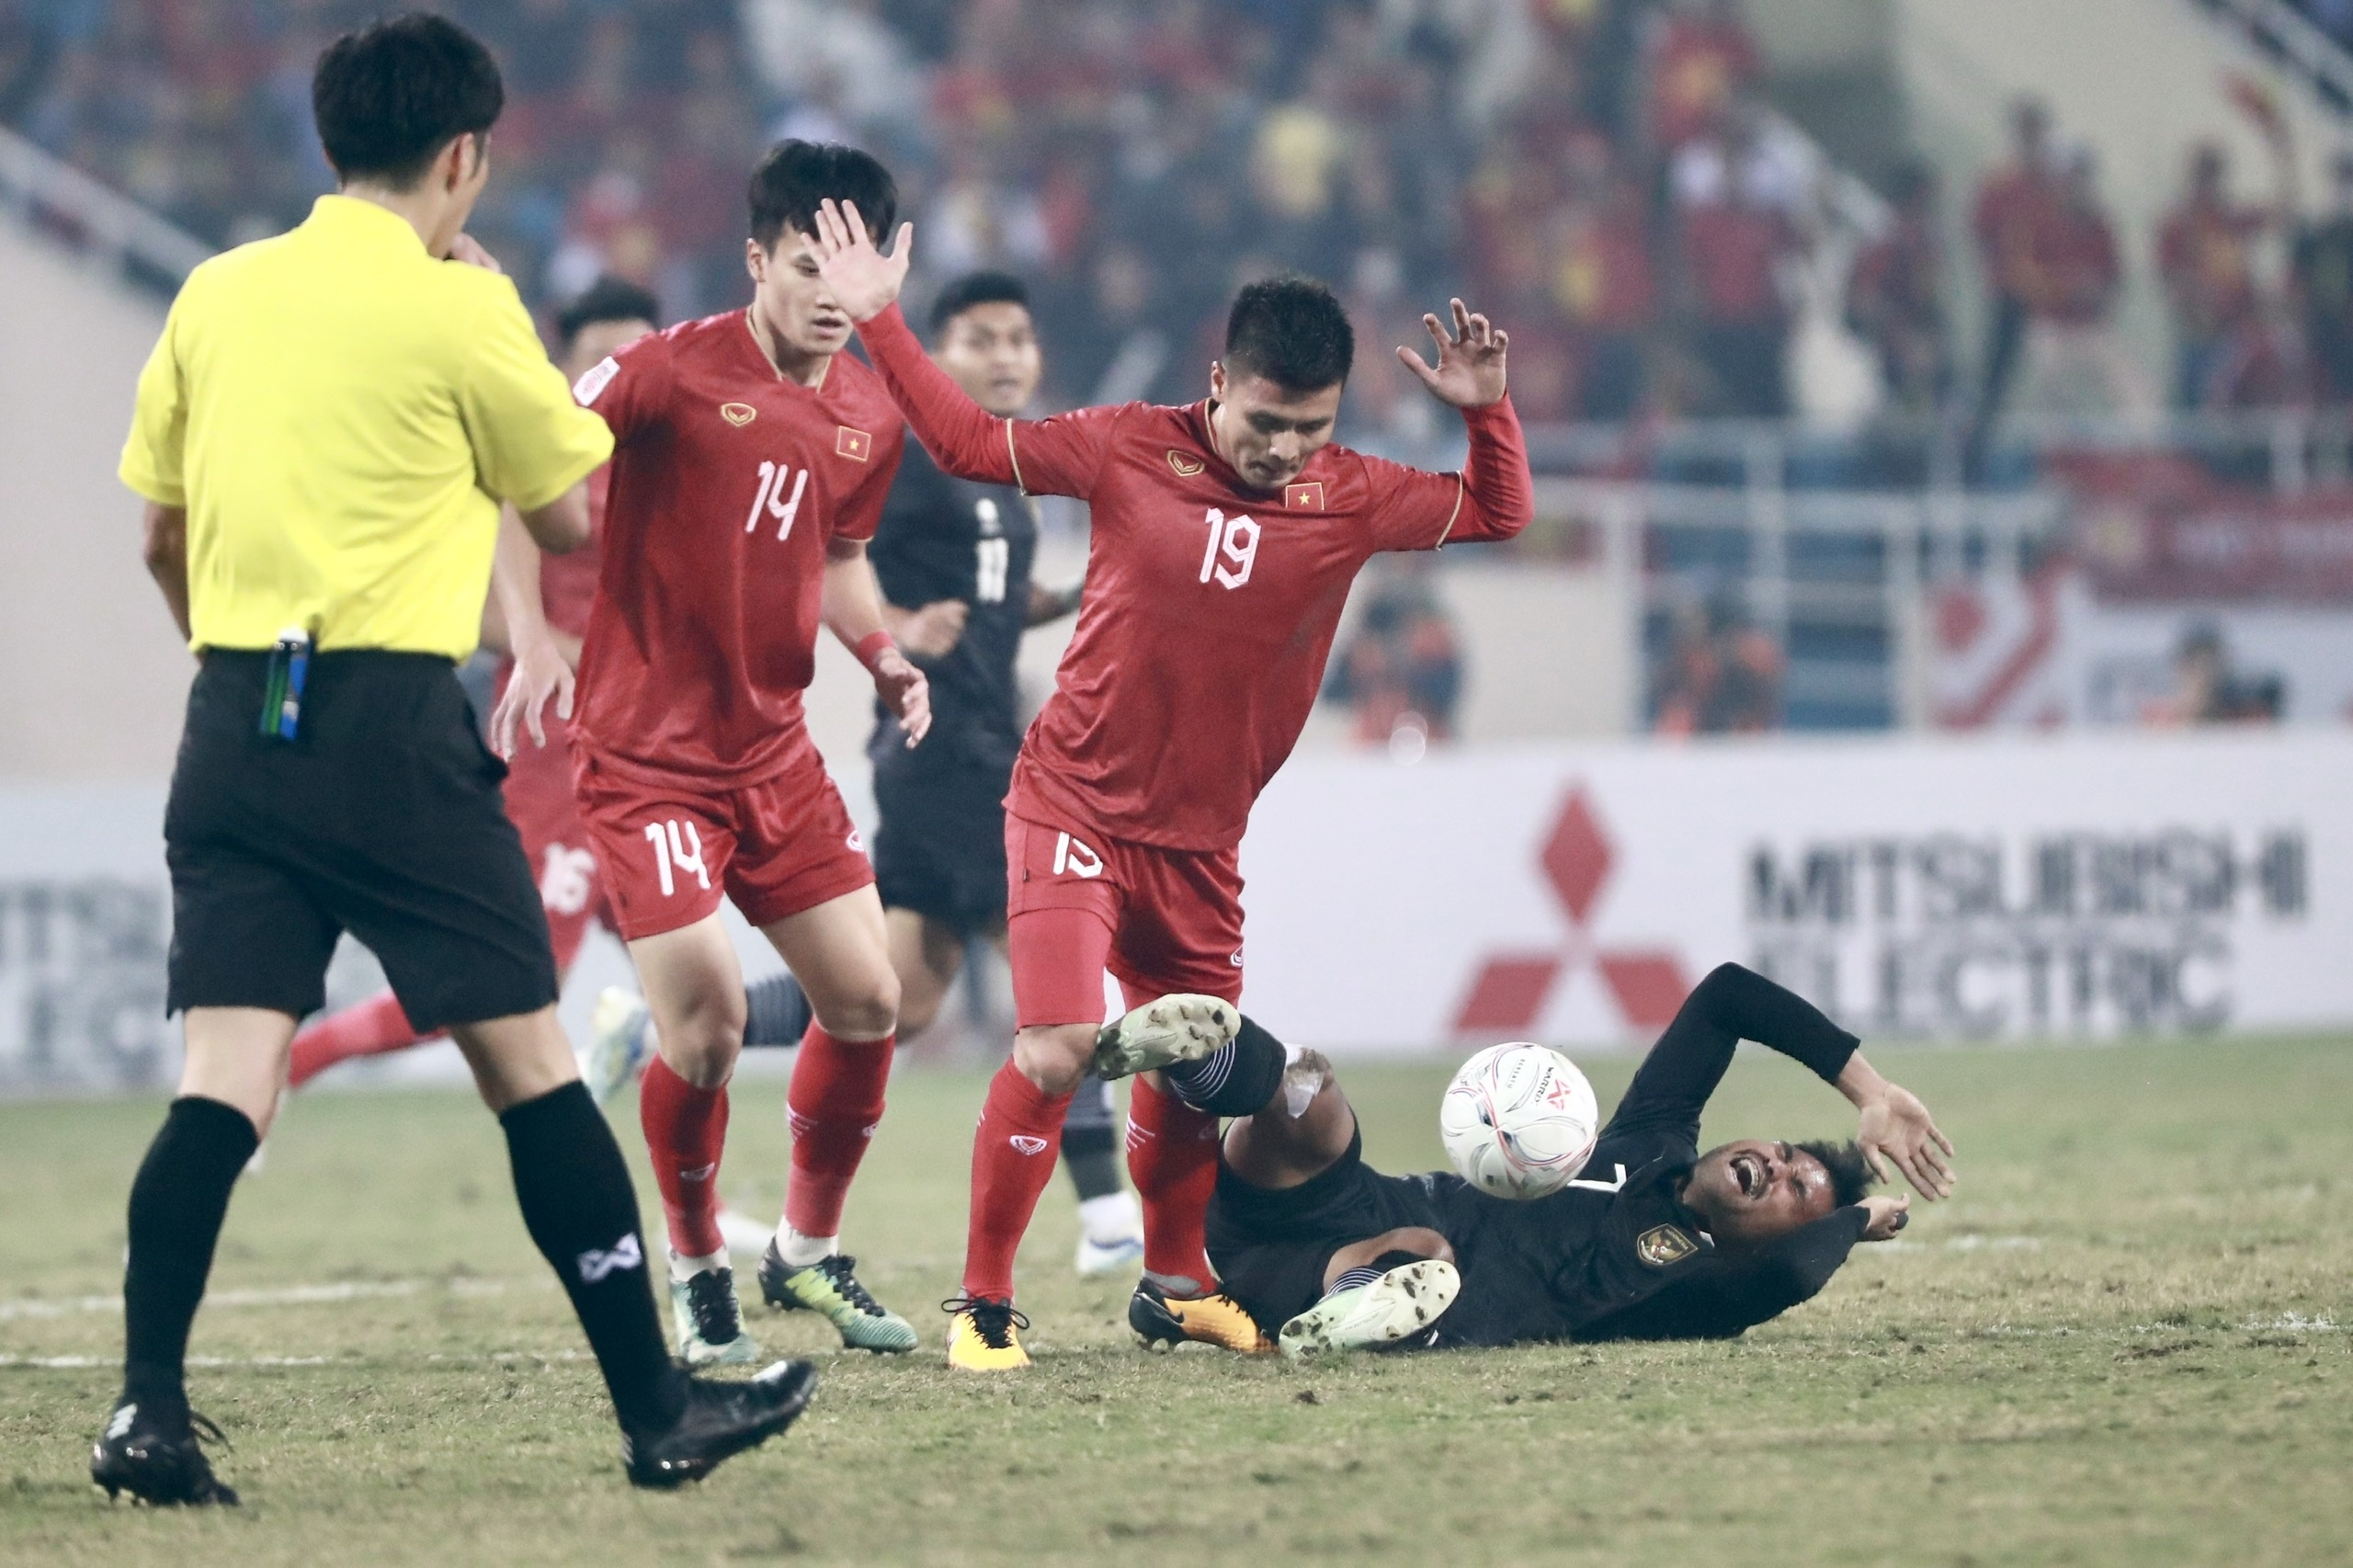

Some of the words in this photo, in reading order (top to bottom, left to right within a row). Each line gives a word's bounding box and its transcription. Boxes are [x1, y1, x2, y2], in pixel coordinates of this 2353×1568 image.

[745, 460, 808, 540] 14
[1199, 507, 1261, 589] 19
[540, 842, 596, 915] 16
[645, 819, 711, 897] 14
[1746, 824, 2311, 924] MITSUBISHI
